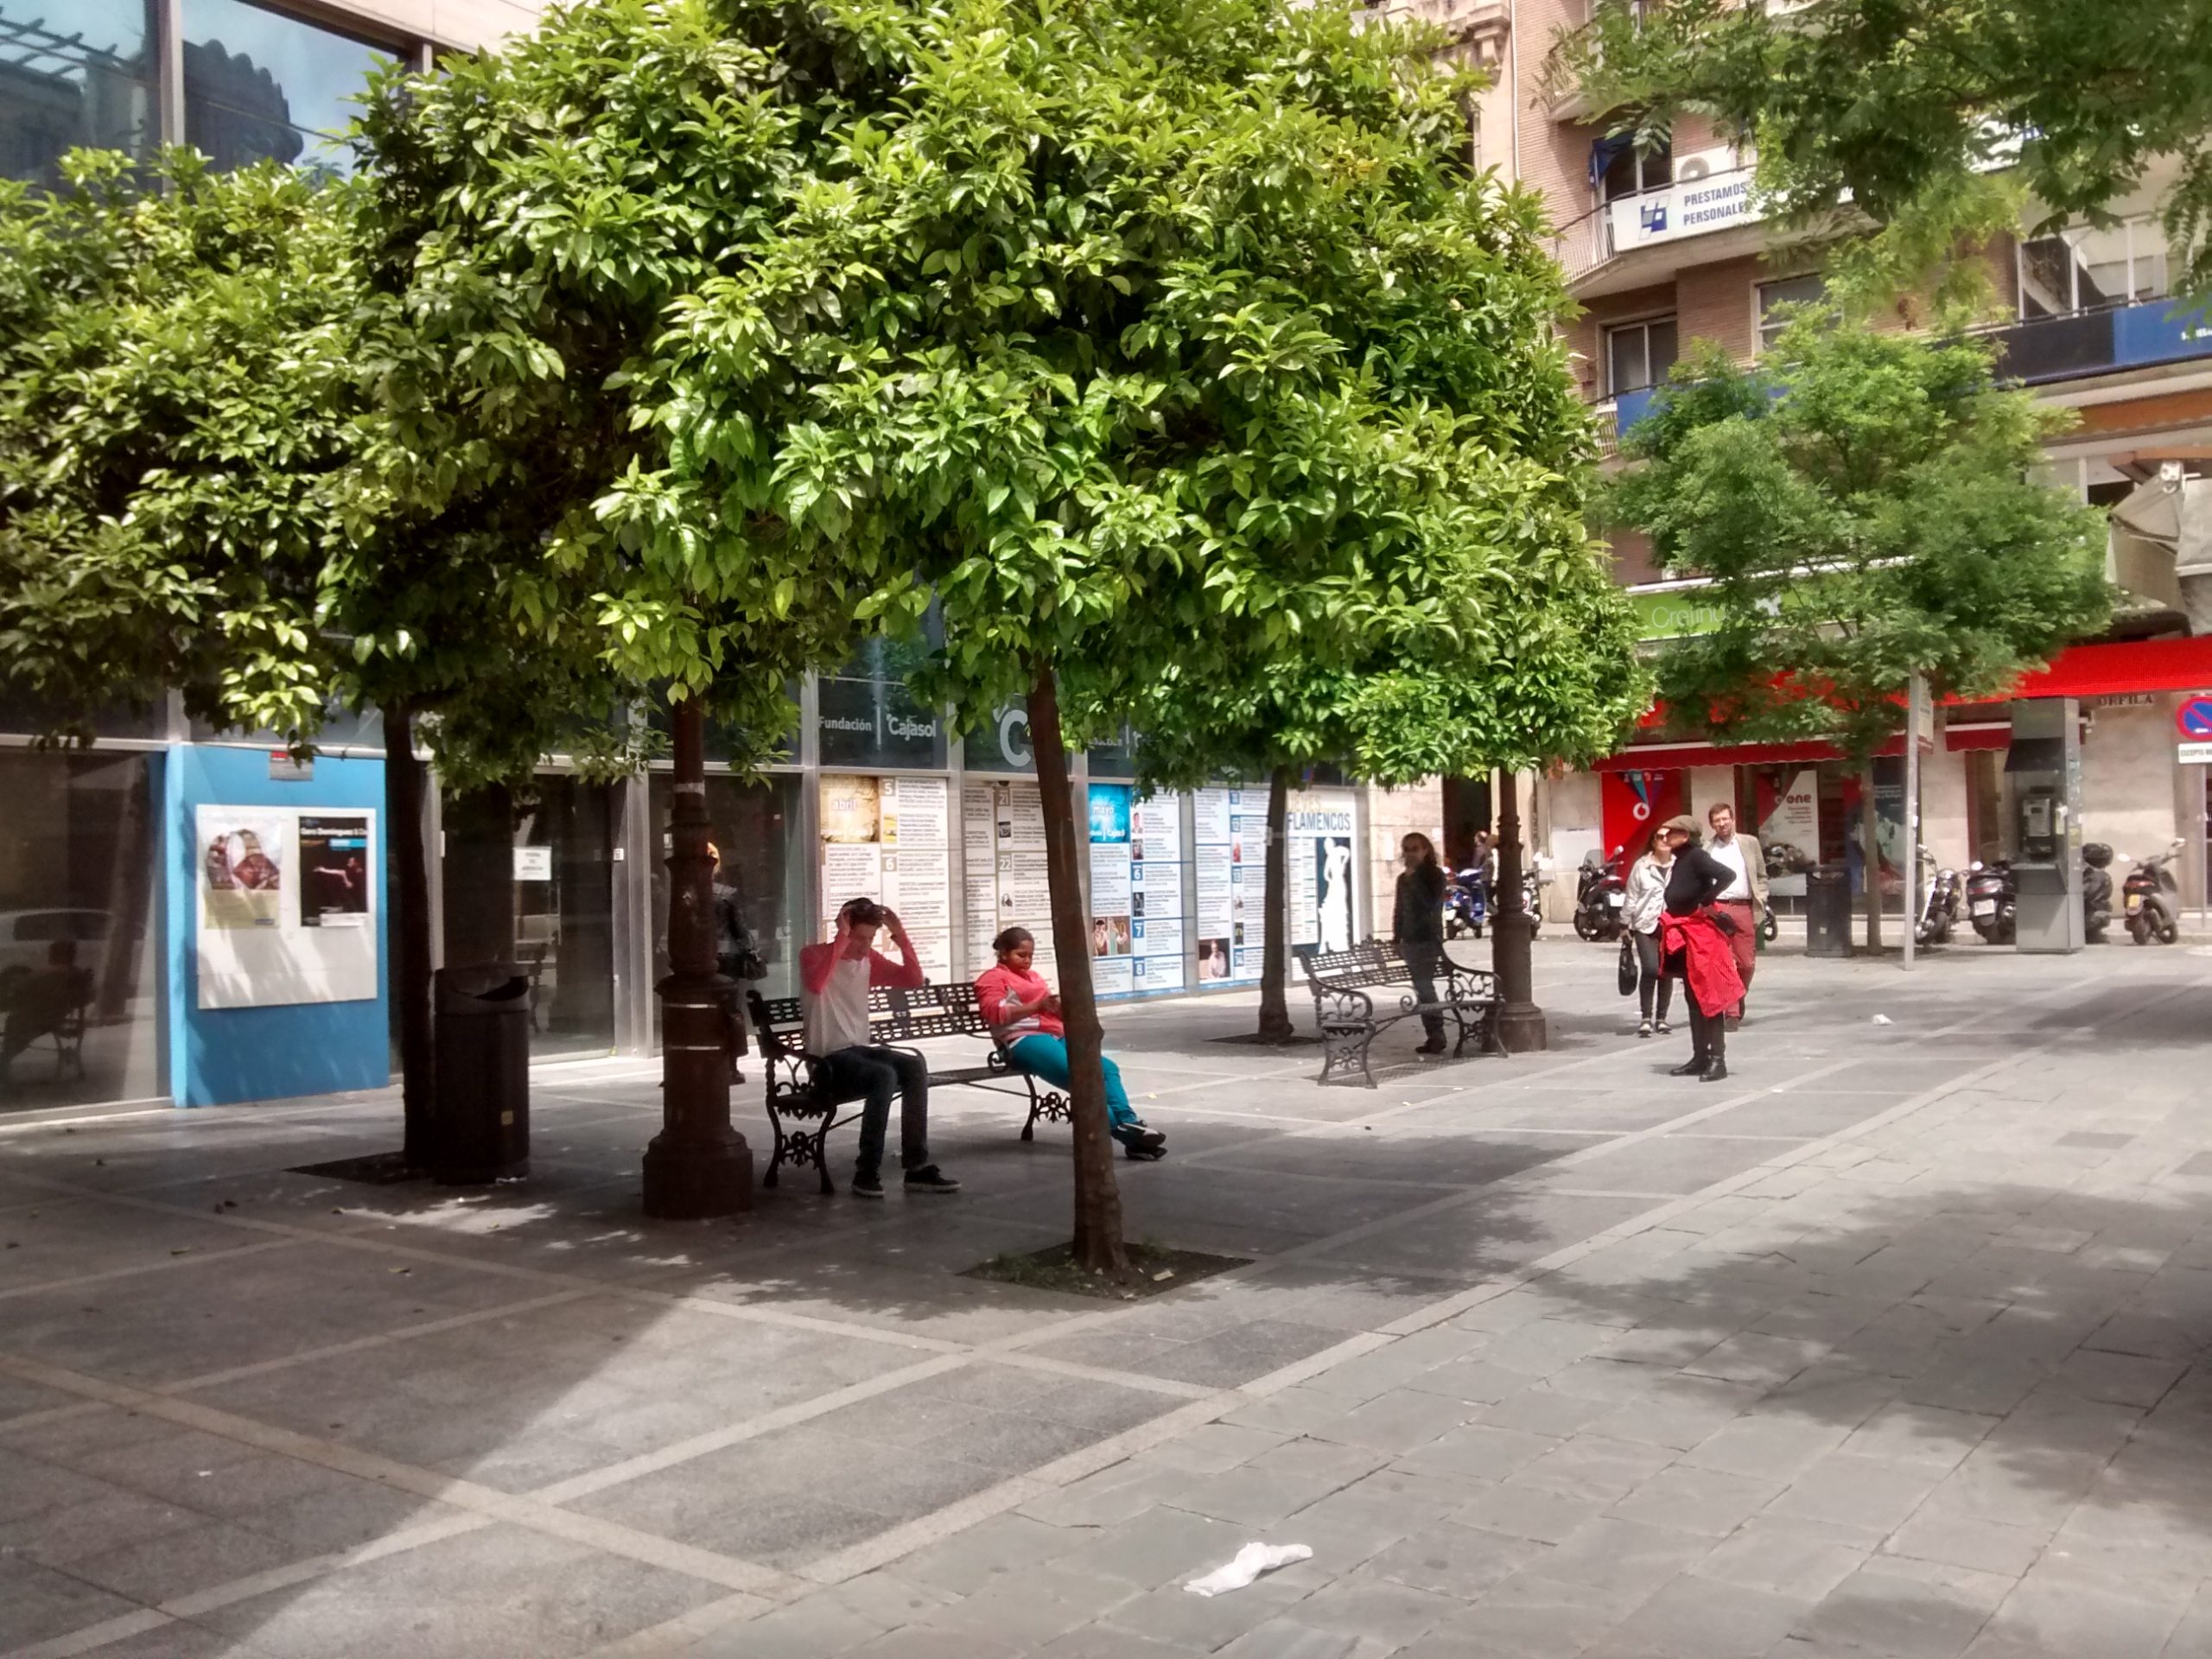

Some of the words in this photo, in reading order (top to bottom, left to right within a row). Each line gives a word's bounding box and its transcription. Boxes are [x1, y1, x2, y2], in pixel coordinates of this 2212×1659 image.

[1683, 181, 1747, 207] PRESTAMOS
[818, 715, 872, 732] Fundación
[887, 714, 937, 741] Cajasol
[884, 782, 893, 795] 5
[832, 798, 858, 810] abril
[1285, 812, 1351, 830] FLAMENCOS
[885, 858, 894, 871] 6
[999, 859, 1012, 871] 22
[1134, 868, 1141, 880] 6
[1135, 926, 1142, 938] 7
